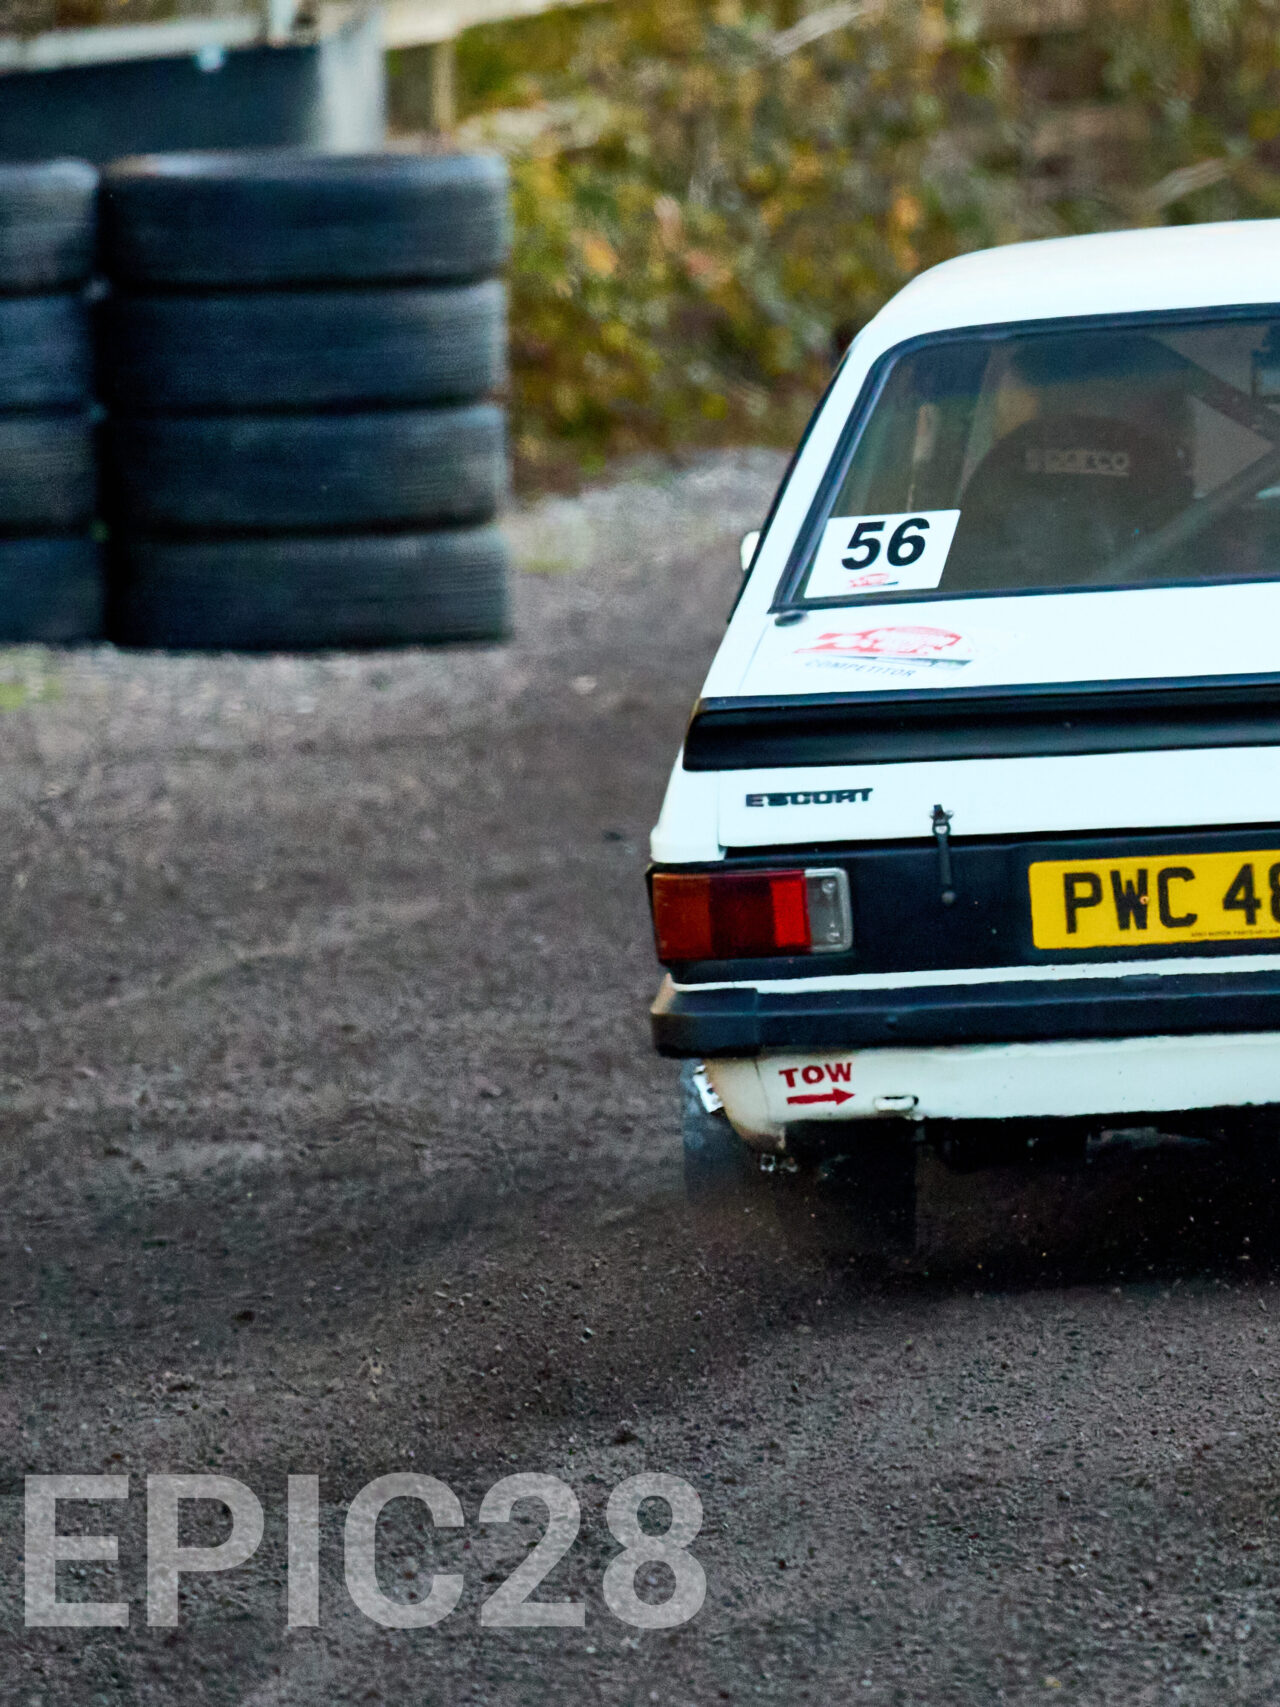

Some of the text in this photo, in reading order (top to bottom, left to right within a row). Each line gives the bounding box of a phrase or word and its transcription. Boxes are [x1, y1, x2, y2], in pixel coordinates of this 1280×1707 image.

[841, 517, 930, 570] 56
[804, 658, 917, 678] COMPETITOR
[746, 788, 873, 807] ESCORT
[1063, 867, 1197, 934] PWC
[778, 1062, 852, 1088] TOW
